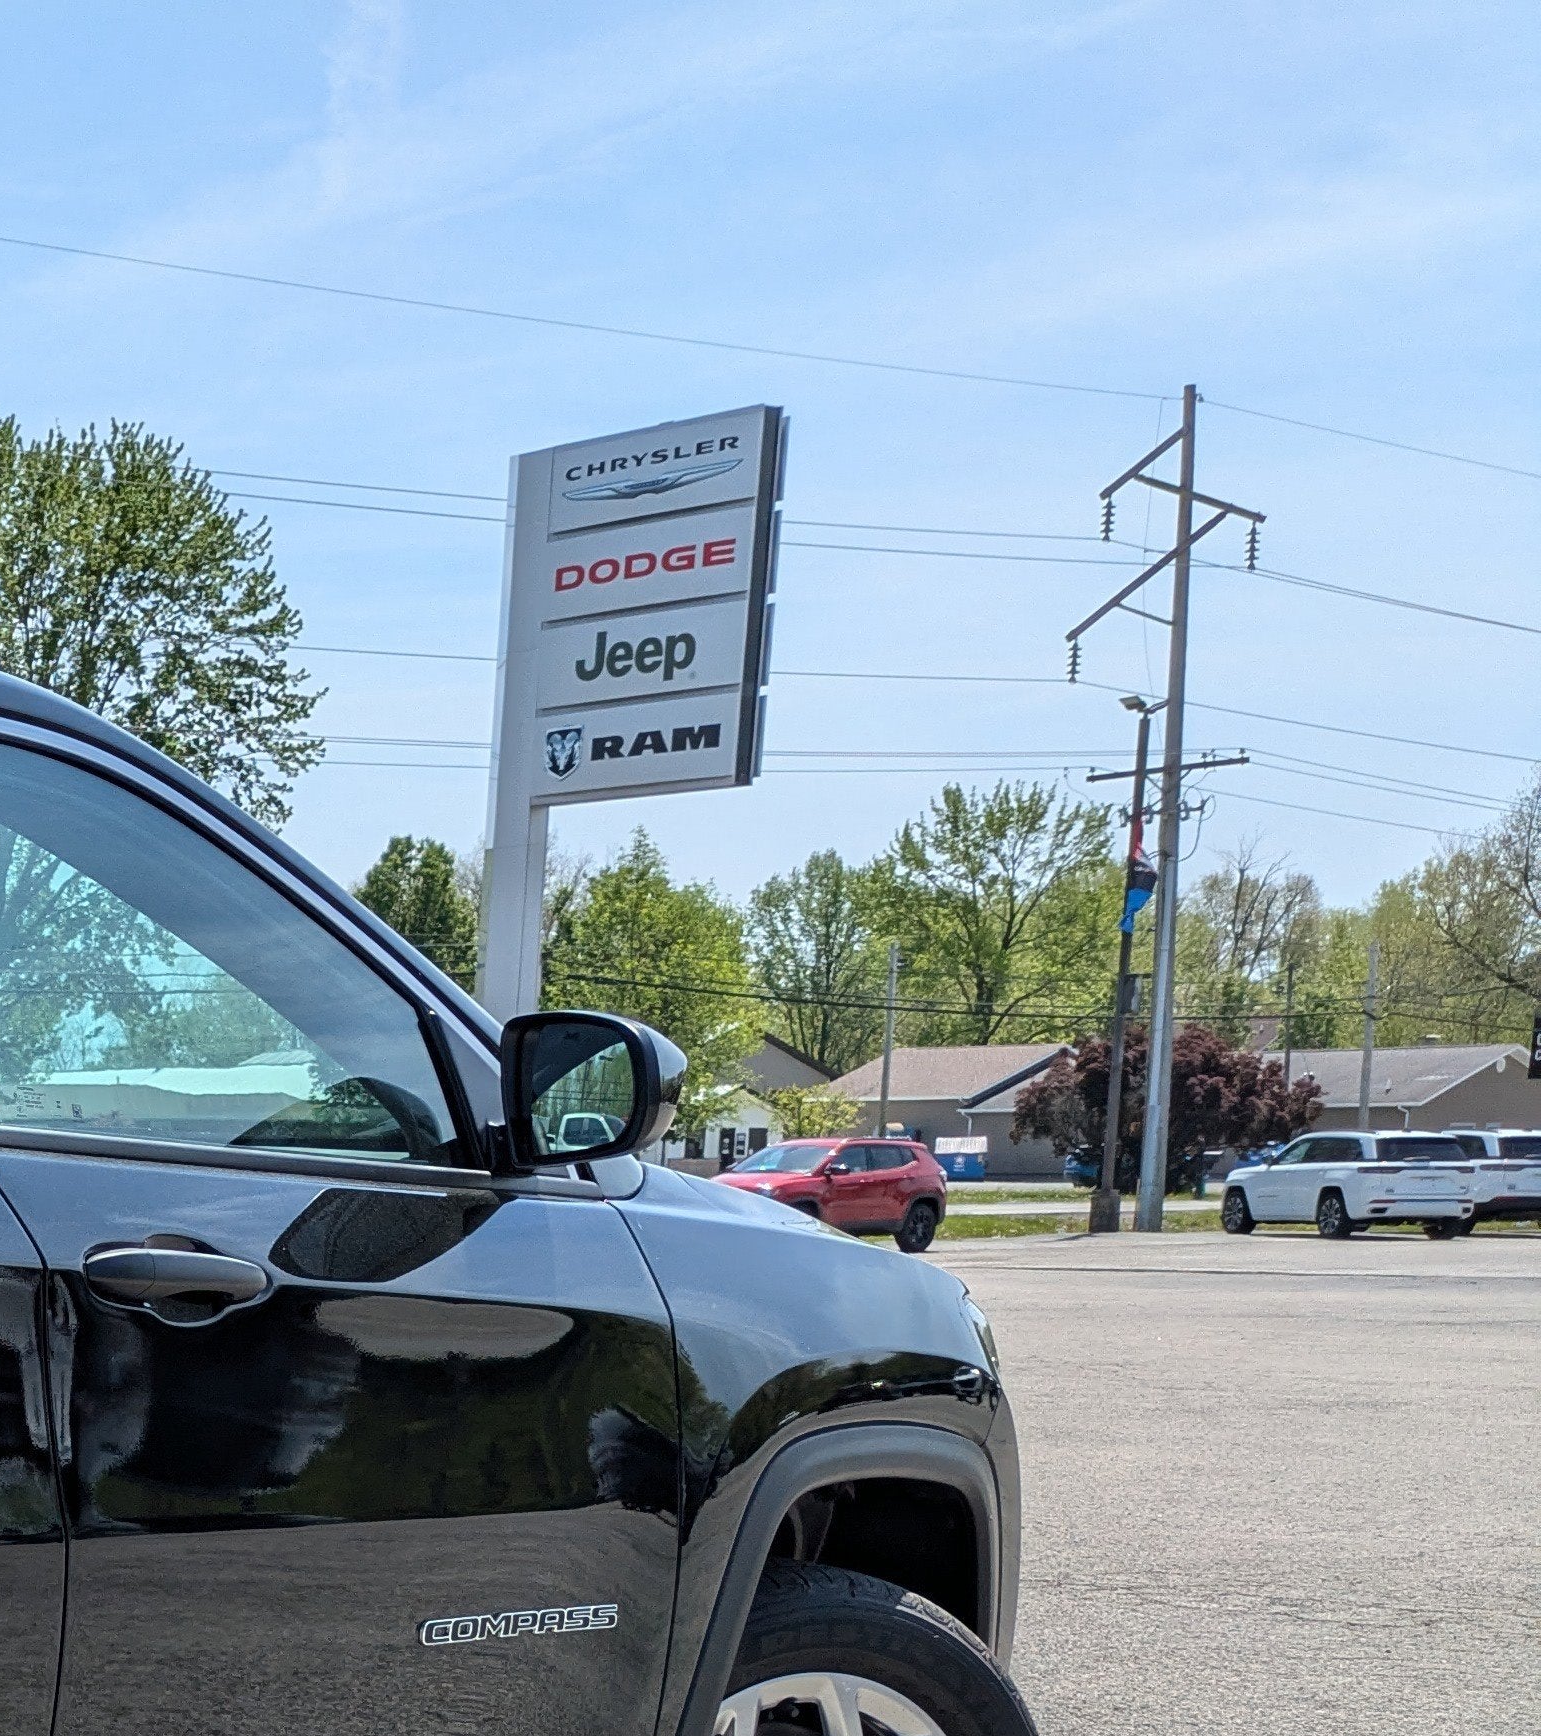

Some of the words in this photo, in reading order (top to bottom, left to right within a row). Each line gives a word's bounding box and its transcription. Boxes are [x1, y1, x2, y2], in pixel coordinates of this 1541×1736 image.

[565, 436, 740, 481] CHRYSLER
[554, 538, 736, 592] DODGE
[575, 631, 696, 682] Jeep
[590, 724, 722, 761] RAM
[419, 1603, 618, 1646] COMPASS
